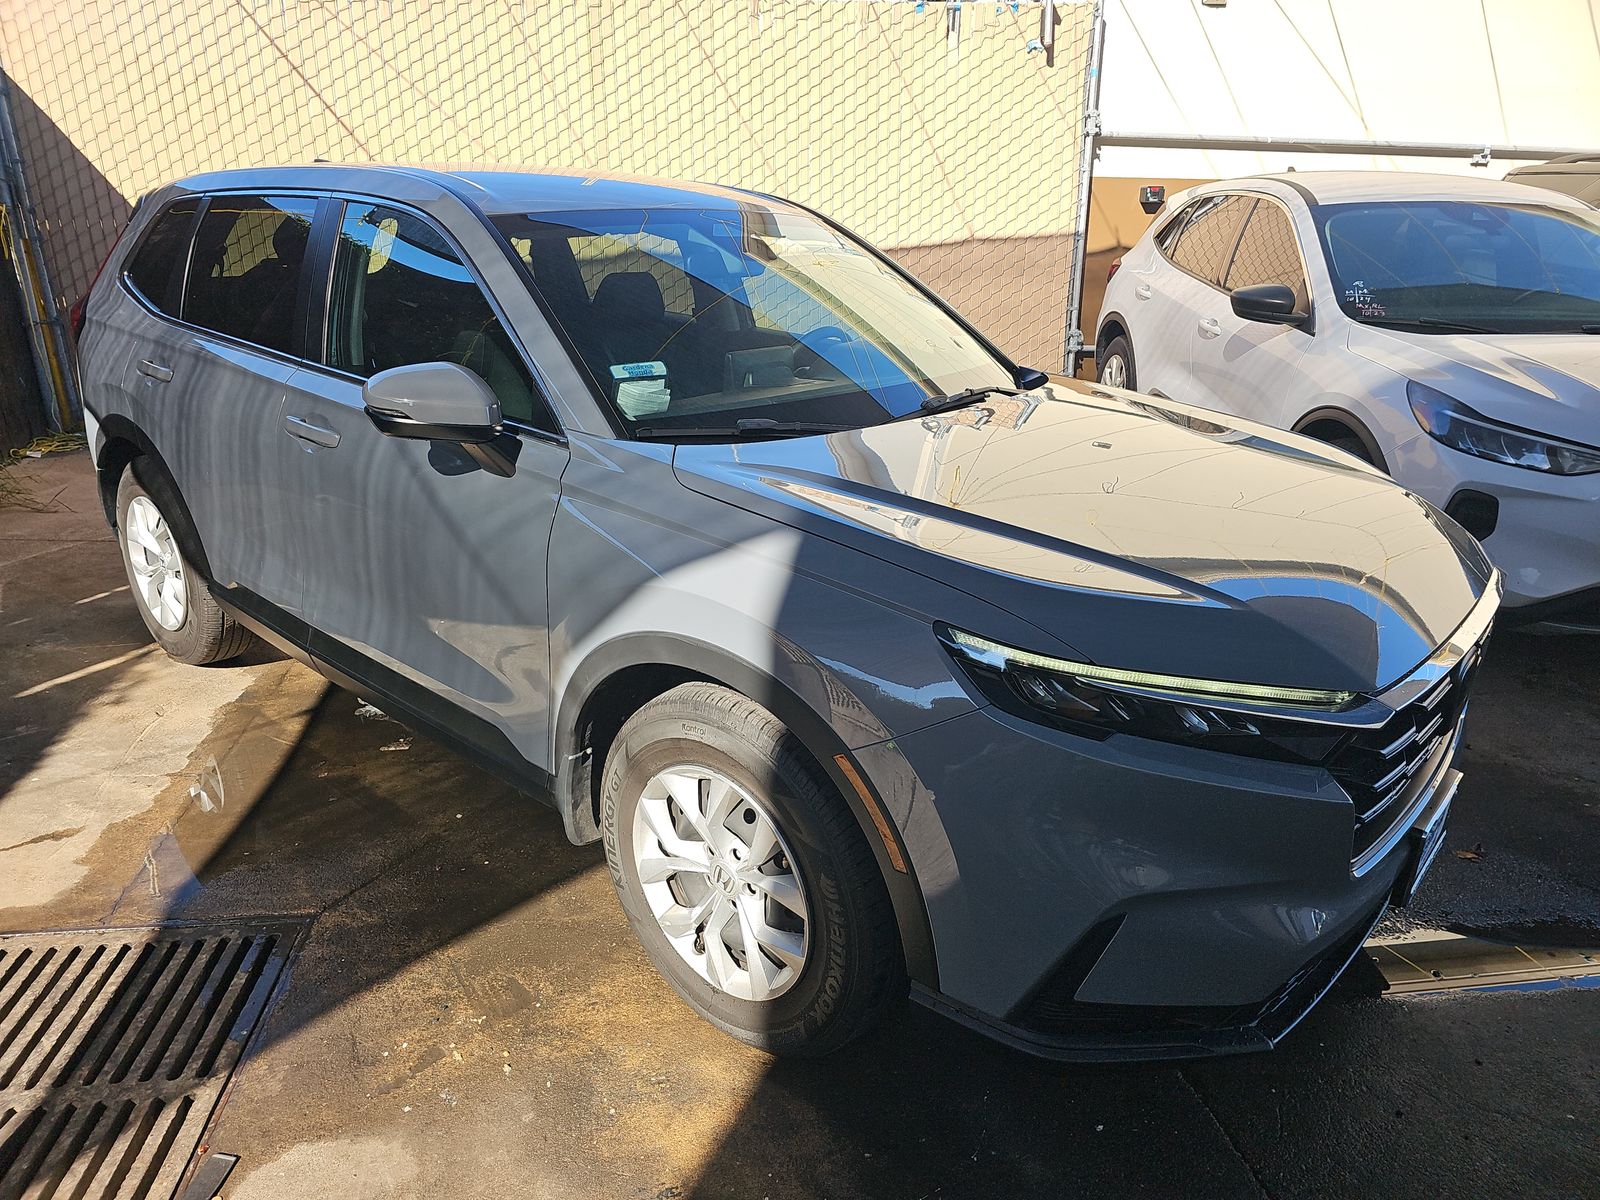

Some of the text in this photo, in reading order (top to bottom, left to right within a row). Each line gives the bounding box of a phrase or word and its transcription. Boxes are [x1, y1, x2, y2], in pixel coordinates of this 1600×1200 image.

[681, 722, 707, 737] Kontrol
[603, 767, 625, 891] KINERGY GT
